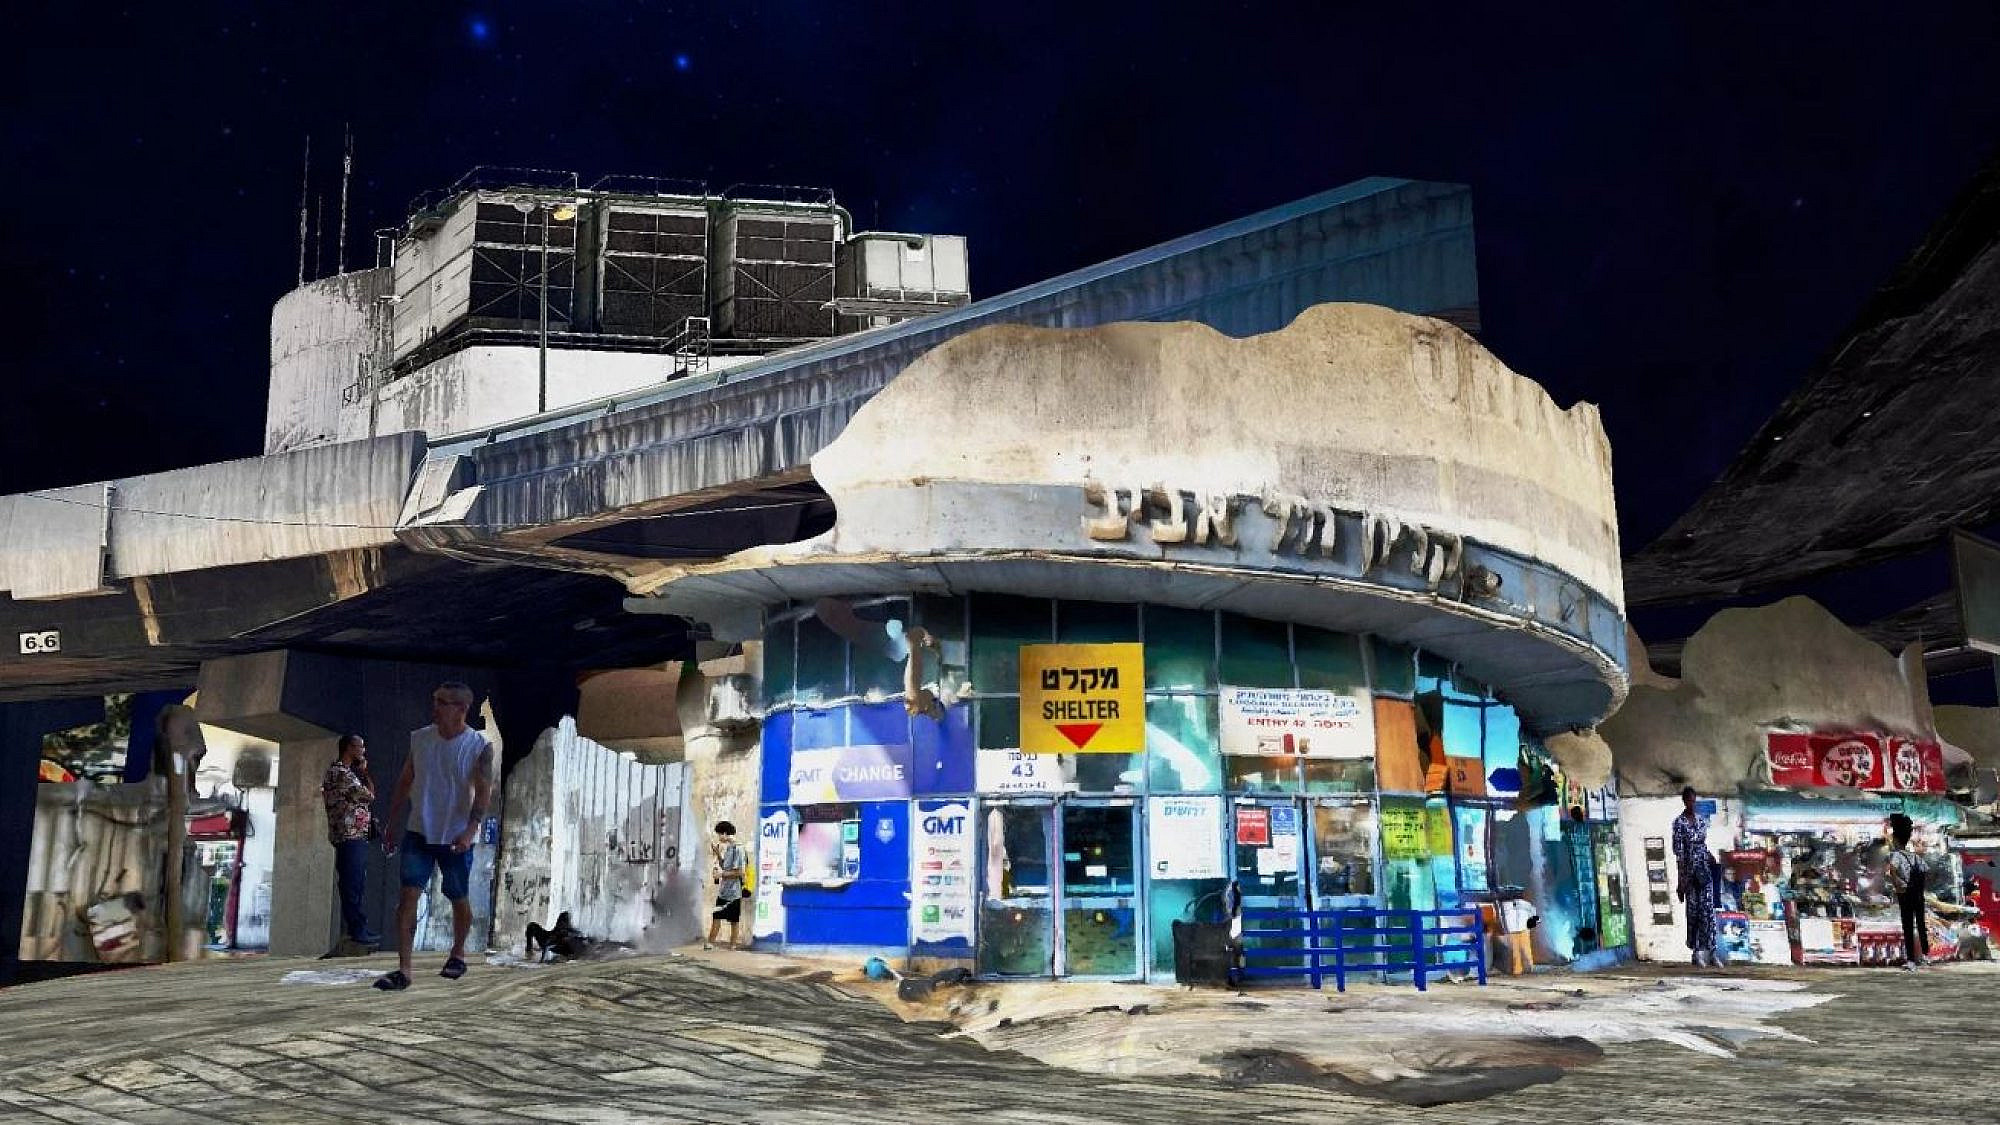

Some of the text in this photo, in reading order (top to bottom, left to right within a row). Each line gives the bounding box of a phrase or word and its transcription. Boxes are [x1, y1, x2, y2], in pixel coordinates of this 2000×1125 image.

[25, 635, 56, 648] 6.6
[1041, 666, 1120, 692] מקלט
[1042, 700, 1120, 721] SHELTER
[1248, 717, 1288, 727] ENTRY
[840, 765, 905, 782] CHANGE
[1011, 763, 1035, 777] 43
[763, 822, 786, 839] GMT
[922, 816, 966, 836] GMT
